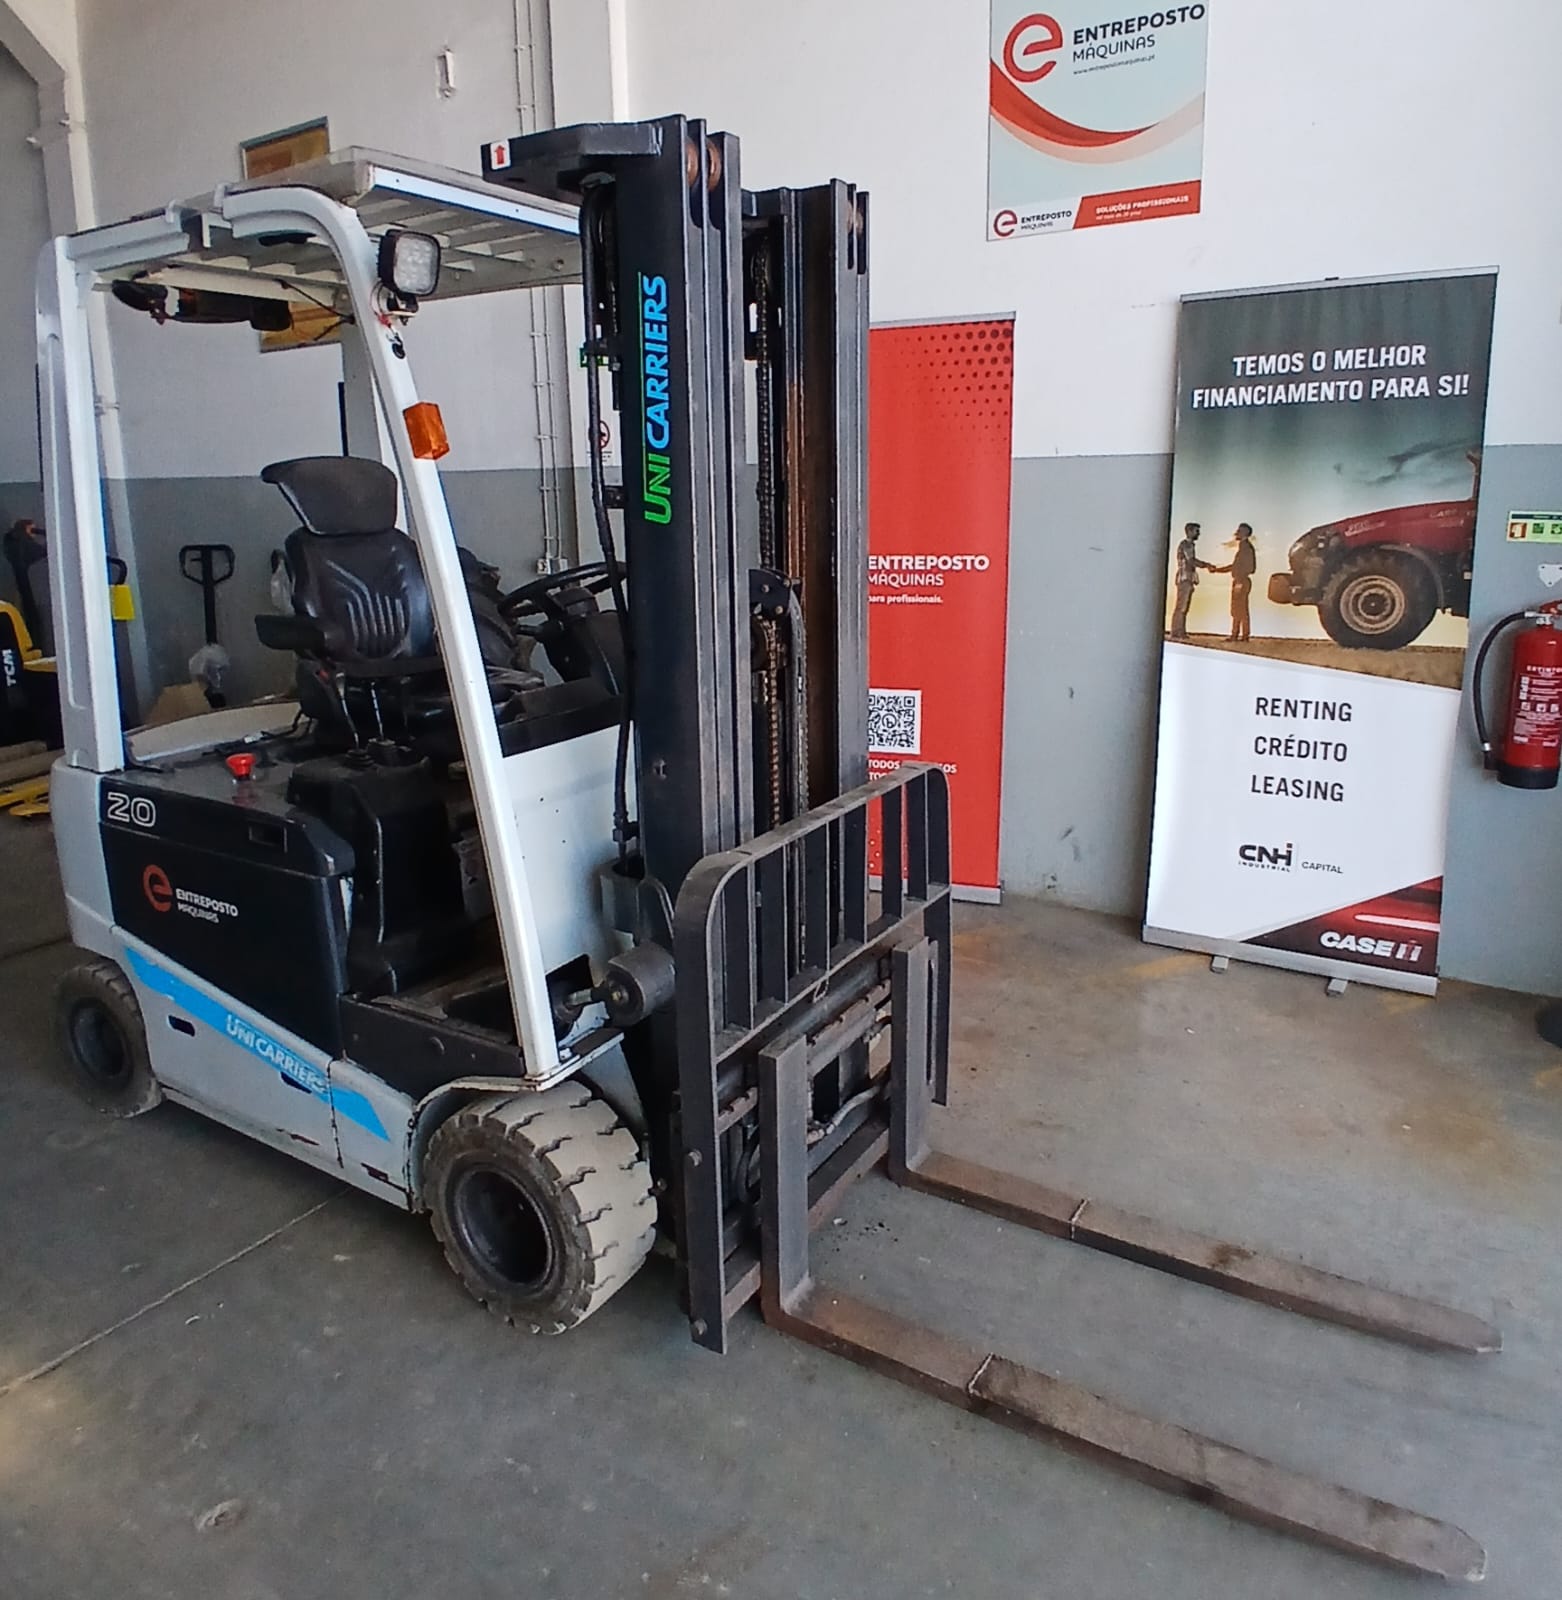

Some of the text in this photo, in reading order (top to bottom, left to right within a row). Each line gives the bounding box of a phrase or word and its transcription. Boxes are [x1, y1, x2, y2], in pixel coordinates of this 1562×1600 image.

[1073, 3, 1205, 45] ENTREPOSTO
[1073, 34, 1155, 62] MÁQUINAS
[1021, 210, 1073, 225] ENTREPOSTO
[1232, 345, 1427, 376] TEMOS O MELHOR
[1192, 374, 1470, 408] FINANCIAMENTO PARA SI!
[868, 554, 990, 571] ENTREPOSTO
[3, 649, 17, 687] TCM
[1255, 696, 1352, 722] RENTING
[1254, 734, 1347, 762] CRÉDITO
[1251, 774, 1344, 802] LEASING
[106, 792, 156, 827] 20
[1238, 860, 1291, 873] INDUSTRIAL
[1301, 861, 1343, 874] CAPITAL
[176, 888, 238, 917] ENTREPOSTO
[1320, 931, 1395, 957] CASE
